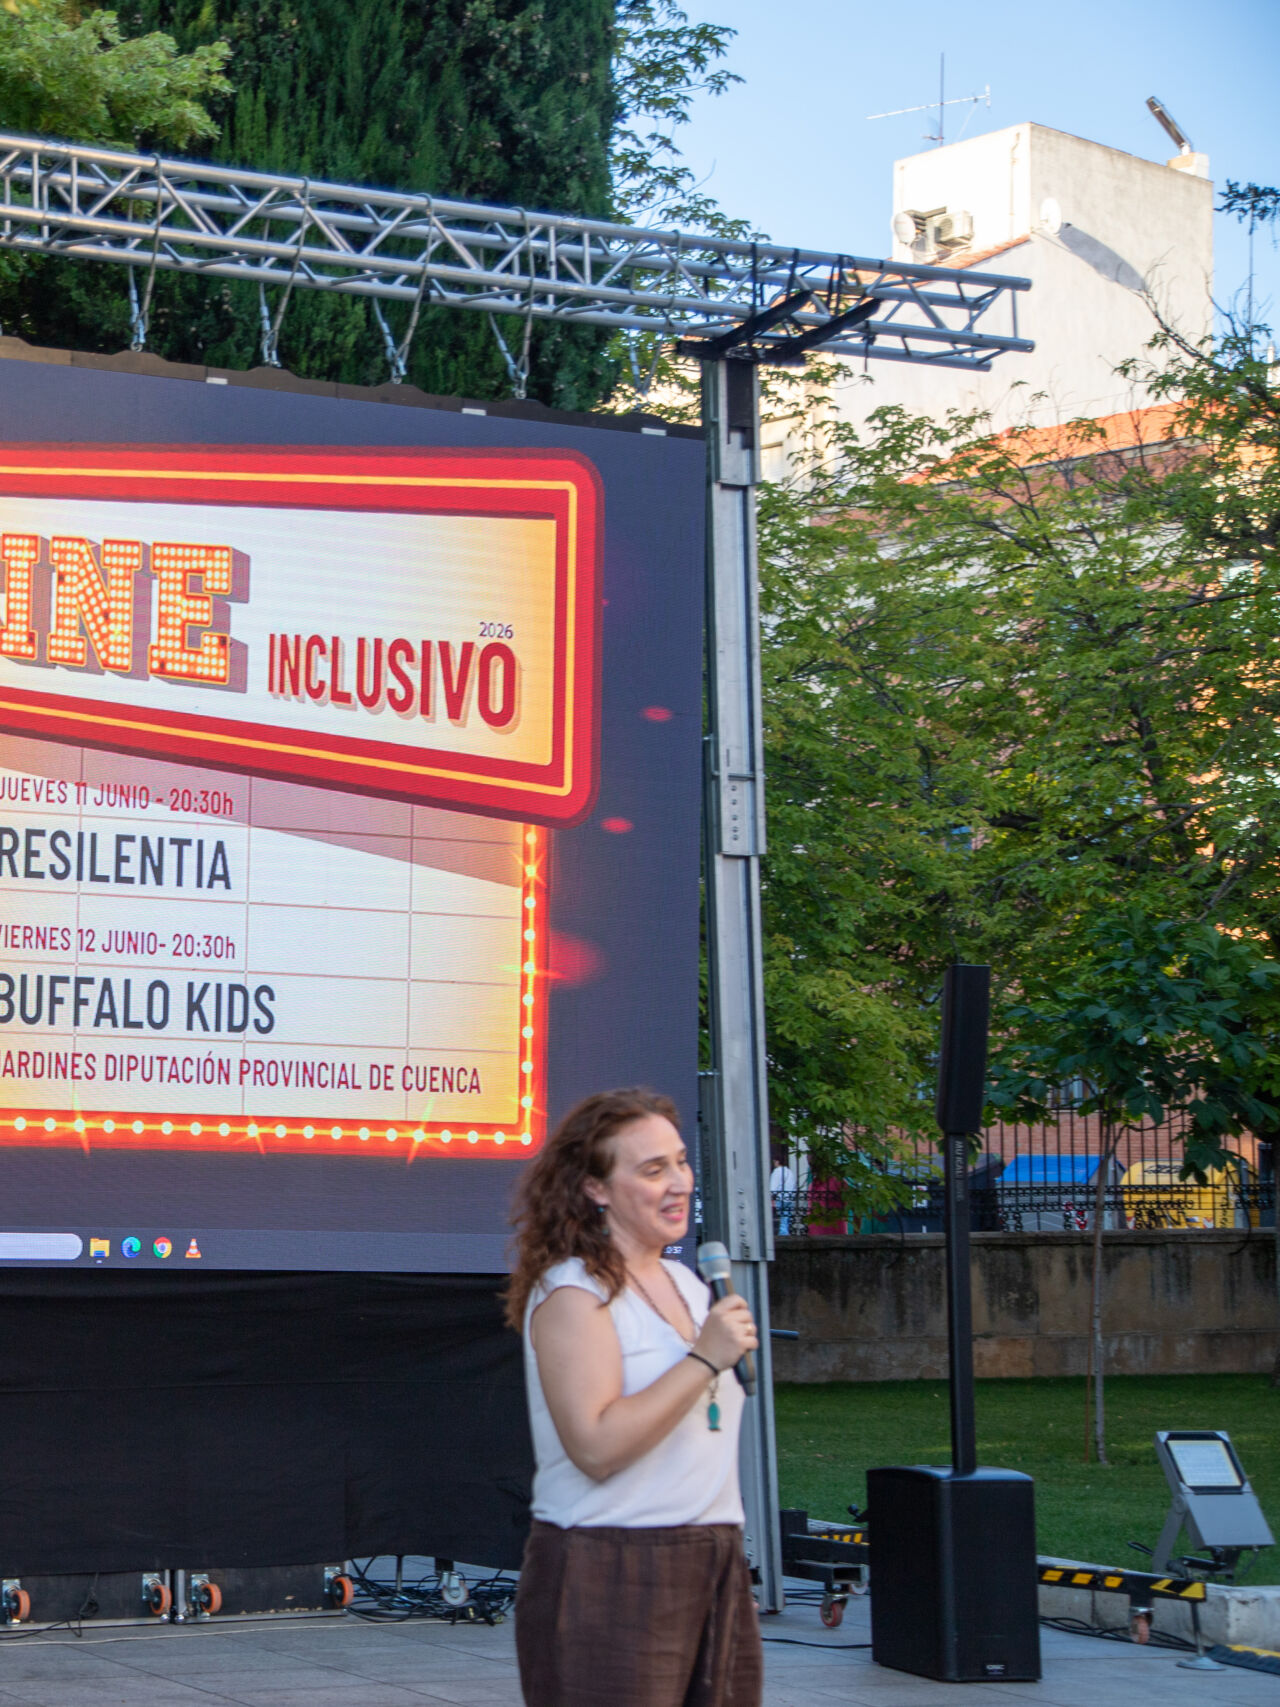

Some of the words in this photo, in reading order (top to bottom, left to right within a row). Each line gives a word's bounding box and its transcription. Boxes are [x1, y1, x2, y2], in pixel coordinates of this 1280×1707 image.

[478, 621, 514, 639] 2026
[267, 632, 518, 730] INCLUSIVO
[74, 781, 88, 806] 11
[93, 783, 150, 810] JUNIO
[169, 788, 234, 816] 20:30h
[77, 928, 96, 953] 12
[171, 933, 236, 960] 20:30h
[185, 981, 276, 1035] KIDS
[104, 1051, 231, 1086] DIPUTACIÓN
[238, 1058, 363, 1091] PROVINCIAL
[369, 1063, 395, 1092] DE
[401, 1065, 481, 1095] CUENCA
